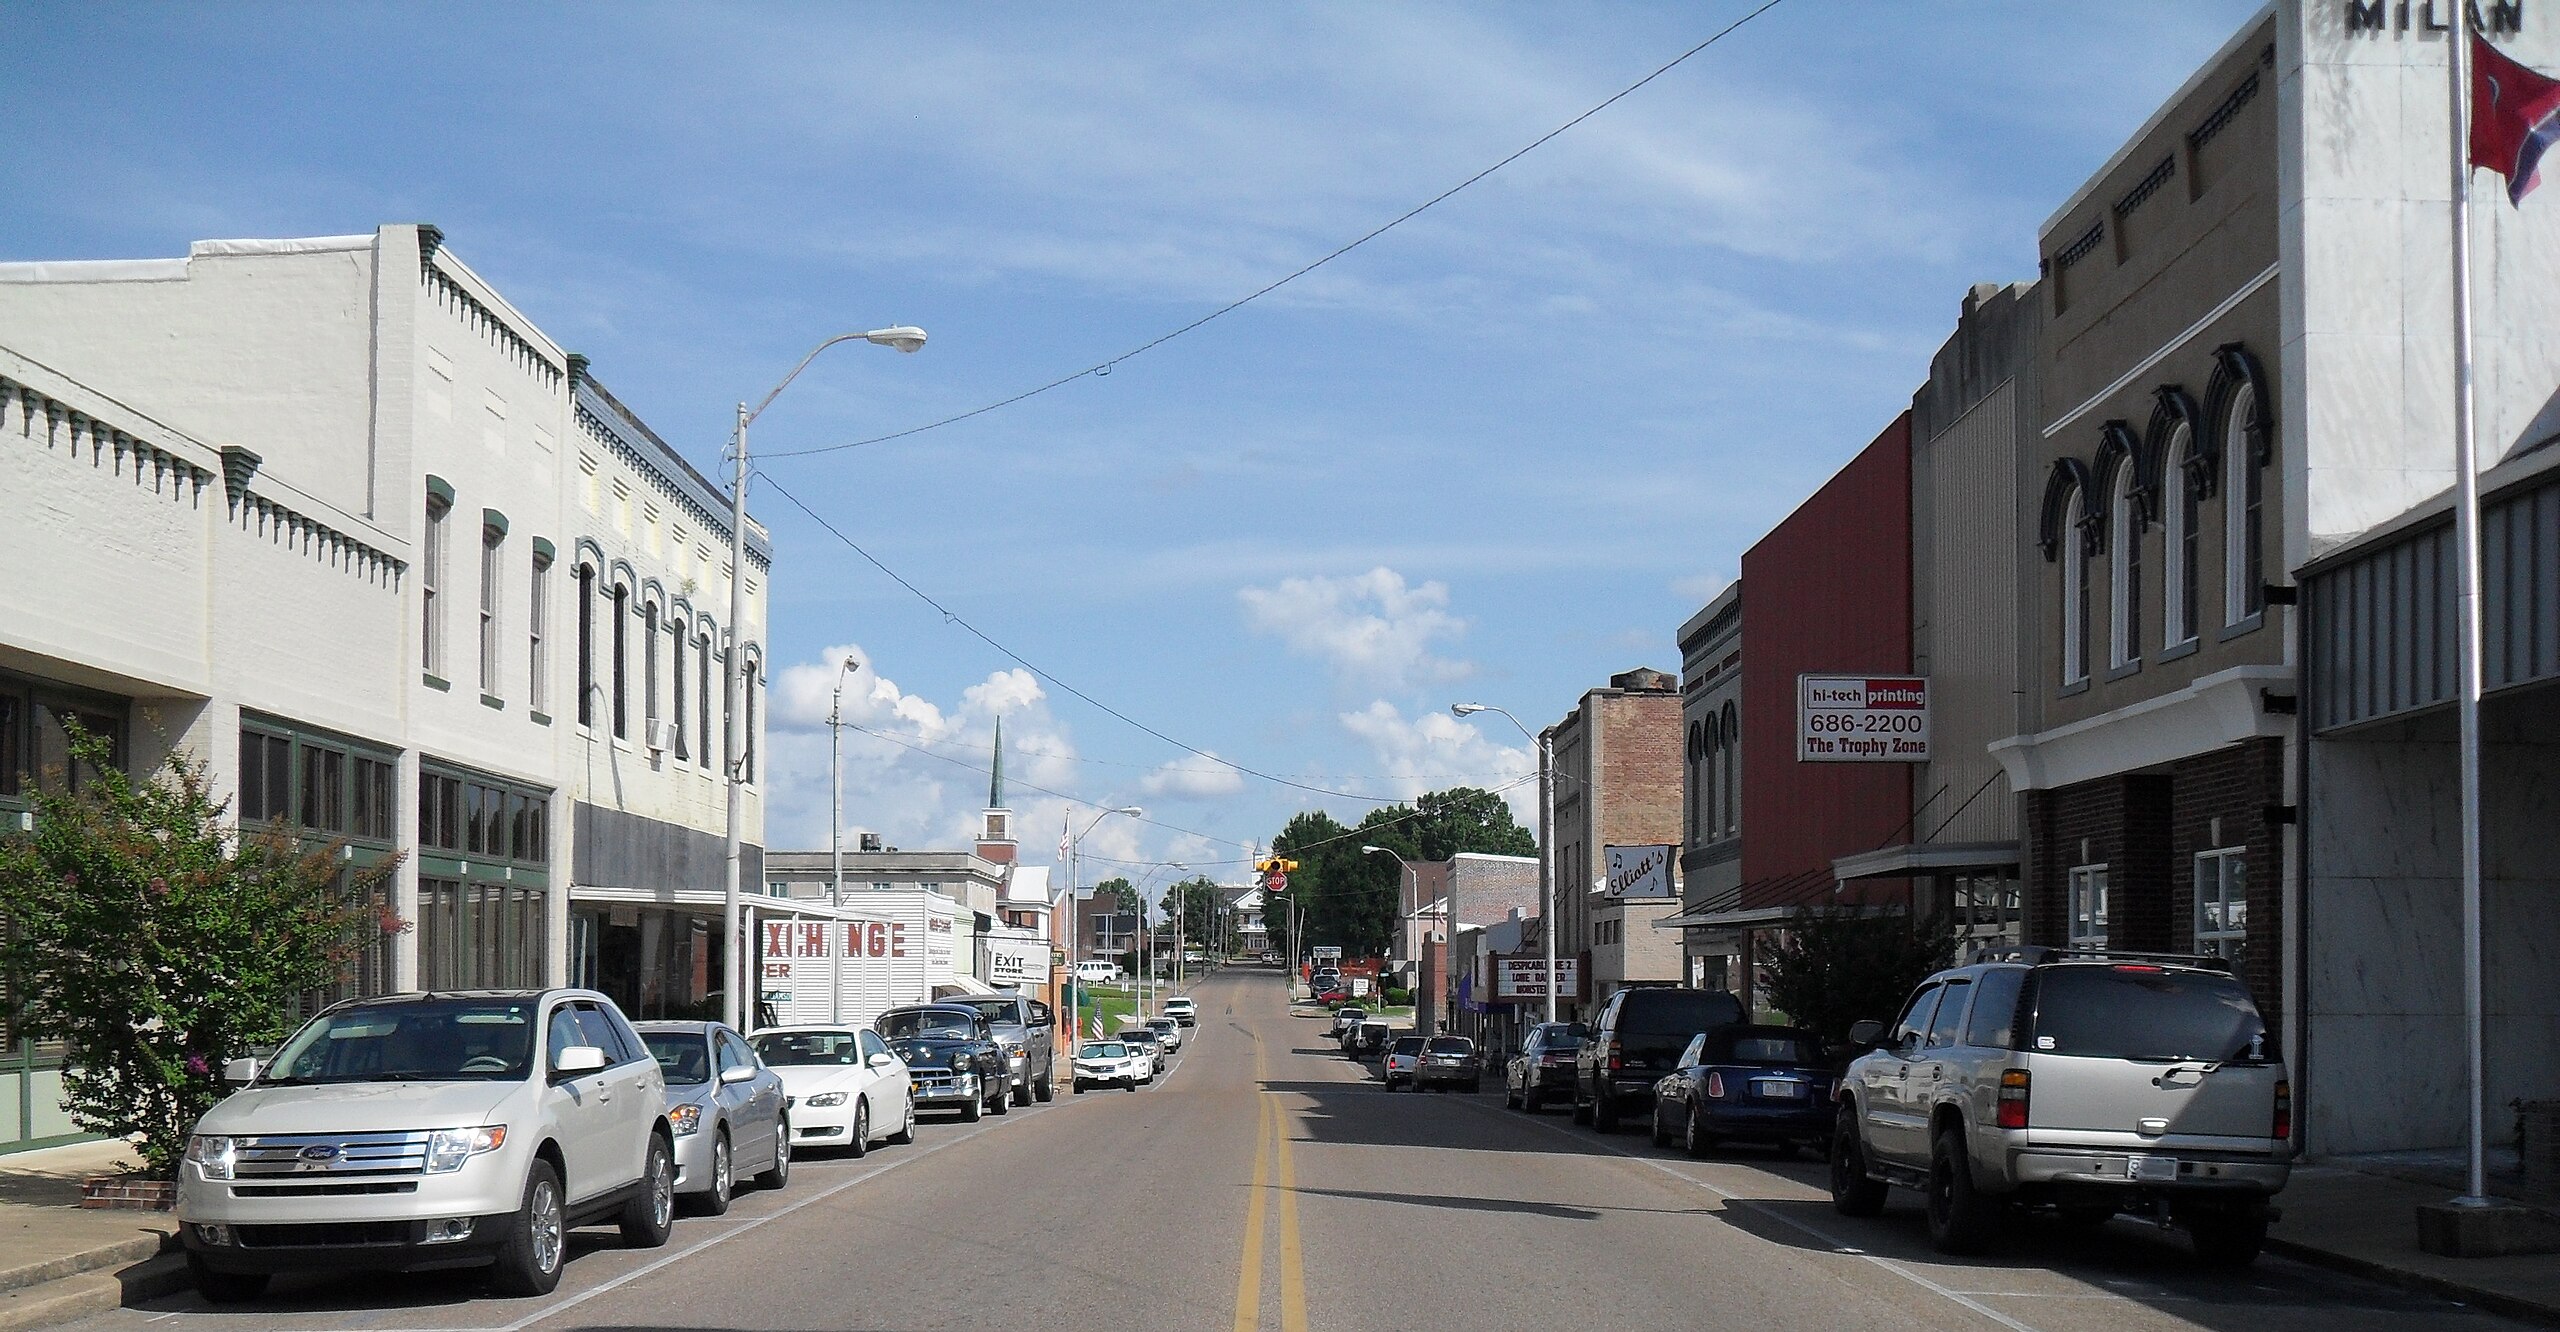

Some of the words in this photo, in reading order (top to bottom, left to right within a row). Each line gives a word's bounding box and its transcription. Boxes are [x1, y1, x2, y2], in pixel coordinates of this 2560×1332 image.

[1813, 689, 1861, 702] hi-tech
[1868, 688, 1925, 705] printing
[1810, 714, 1922, 733] 686-2200
[1807, 736, 1833, 754] The
[1839, 736, 1887, 757] Trophy
[1892, 736, 1926, 754] Zone
[1267, 876, 1285, 885] STOP
[1610, 850, 1664, 896] Elliott's
[767, 923, 905, 957] XCHNGE
[995, 952, 1024, 967] EXIT
[1567, 960, 1572, 970] 2
[764, 963, 790, 977] ER
[1512, 973, 1530, 982] LONE
[1535, 972, 1566, 982] RAER
[308, 1147, 331, 1157] Ford
